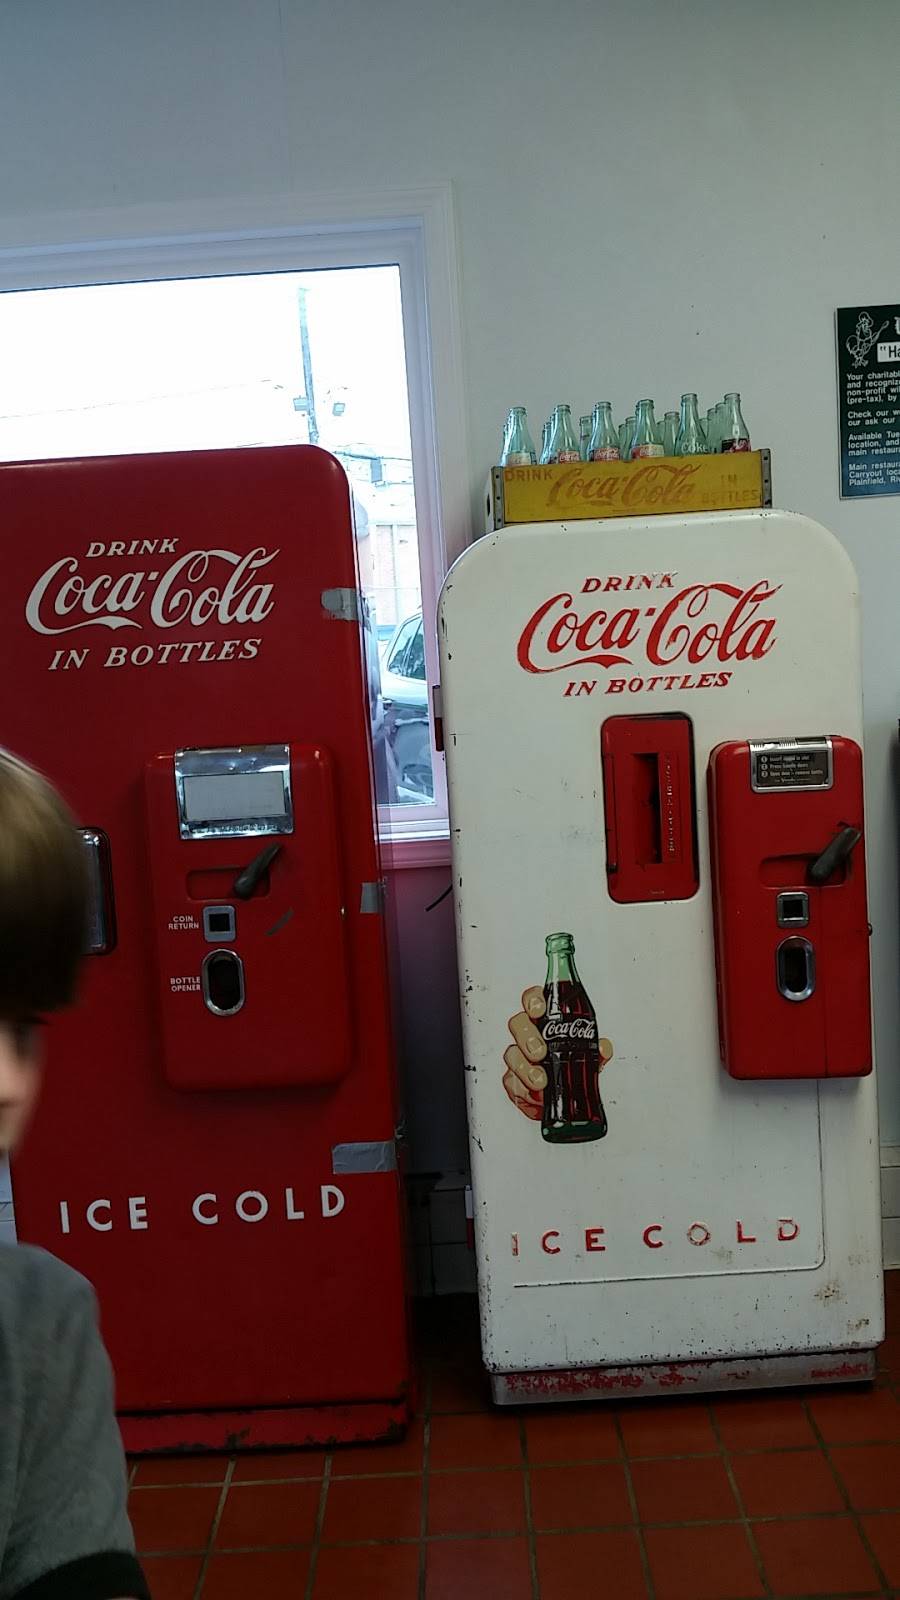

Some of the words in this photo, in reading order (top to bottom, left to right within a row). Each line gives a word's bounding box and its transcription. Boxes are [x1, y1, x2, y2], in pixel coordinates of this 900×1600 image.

[847, 381, 861, 389] and
[847, 386, 886, 396] non-profit
[887, 394, 897, 402] by
[848, 410, 872, 419] Check
[865, 417, 878, 425] ask
[886, 438, 899, 446] and
[871, 447, 900, 455] restaur
[504, 467, 553, 483] DRINK
[849, 470, 882, 479] Carryout
[546, 462, 701, 508] Coca-Cola
[703, 489, 759, 505] BTTLES
[86, 538, 180, 558] DRINK
[580, 571, 678, 593] DRINK
[26, 547, 280, 635] Coca-Cola
[517, 580, 783, 674] Coca-Cola
[48, 649, 90, 670] IN
[104, 638, 262, 668] BOTTLES
[562, 680, 597, 697] IN
[604, 671, 733, 695] BOTTLES
[168, 922, 199, 930] RETURN
[170, 976, 201, 985] BOTTLE
[171, 984, 201, 992] OPENER
[542, 1018, 596, 1041] Coca-Cola
[60, 1196, 149, 1234] ICE
[192, 1184, 346, 1225] COLD
[511, 1227, 606, 1257] ICE
[642, 1217, 800, 1249] COLD
